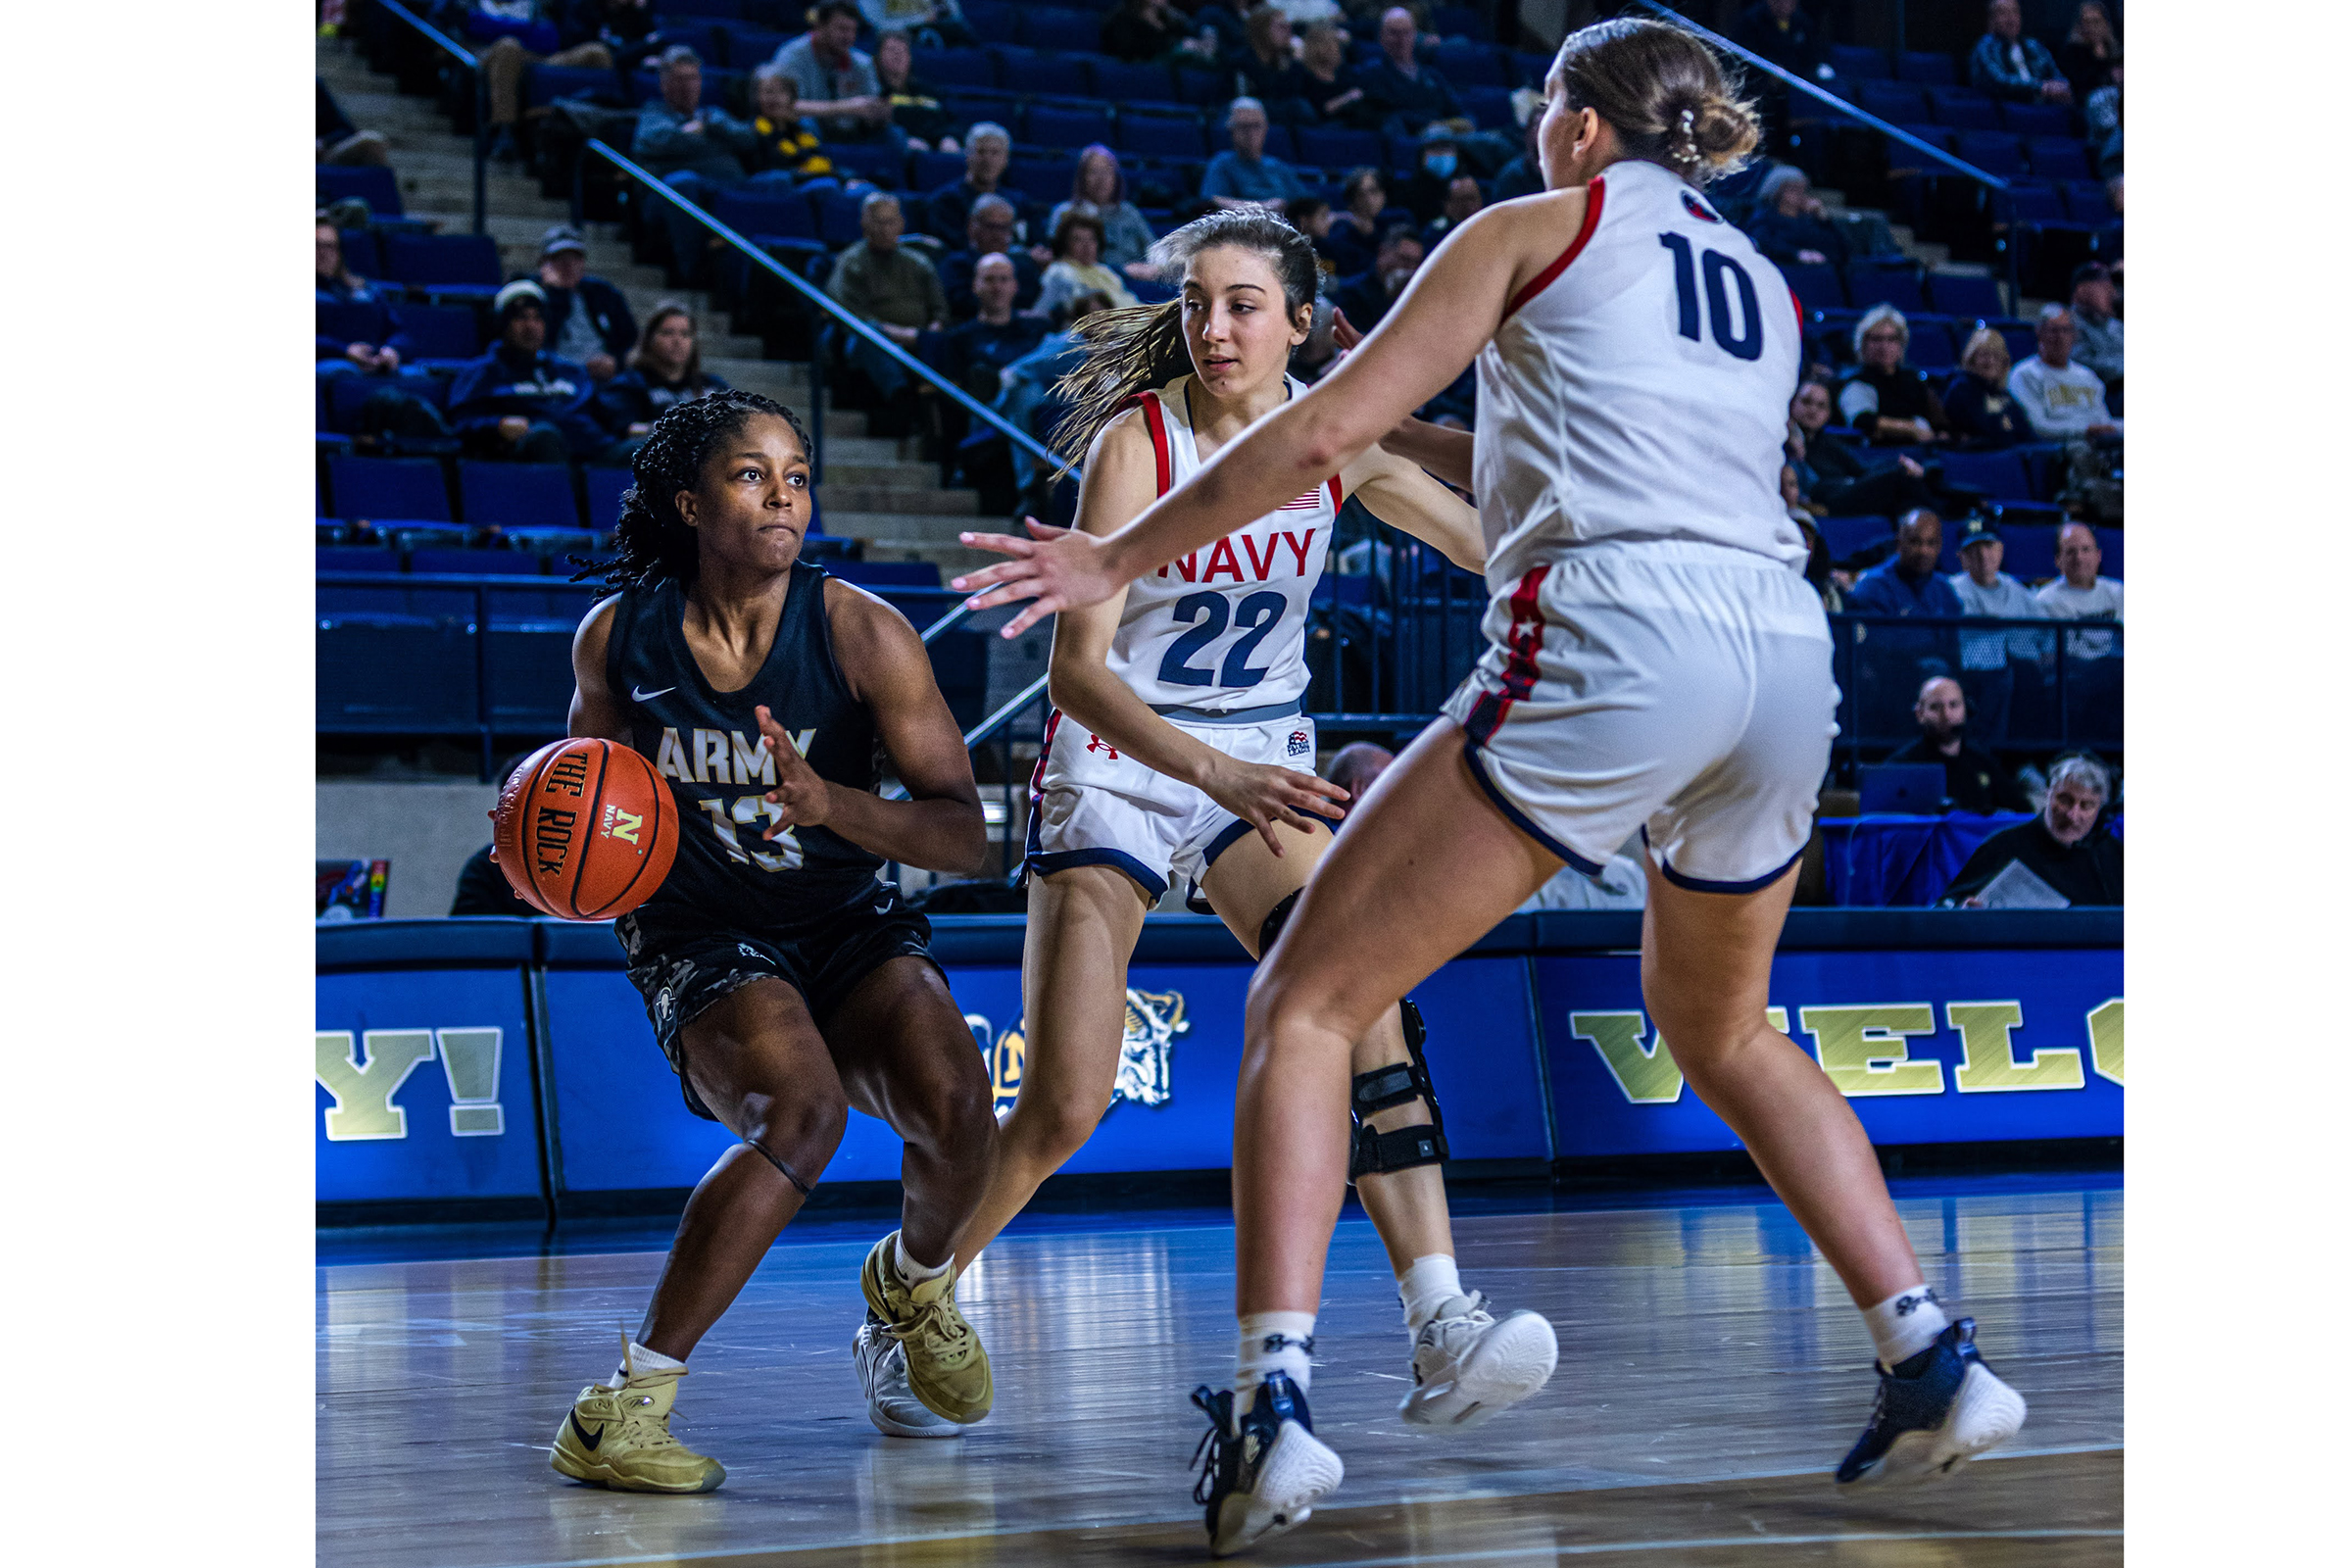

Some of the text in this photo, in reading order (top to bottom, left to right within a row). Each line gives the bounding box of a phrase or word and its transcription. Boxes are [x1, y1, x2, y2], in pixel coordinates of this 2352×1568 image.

[1658, 230, 1763, 363] 10
[1157, 528, 1316, 583] NAVY
[1157, 590, 1288, 688] 22
[536, 752, 588, 876] THE ROCK
[601, 804, 615, 839] NAVY
[612, 808, 643, 846] N
[698, 794, 805, 872] 13
